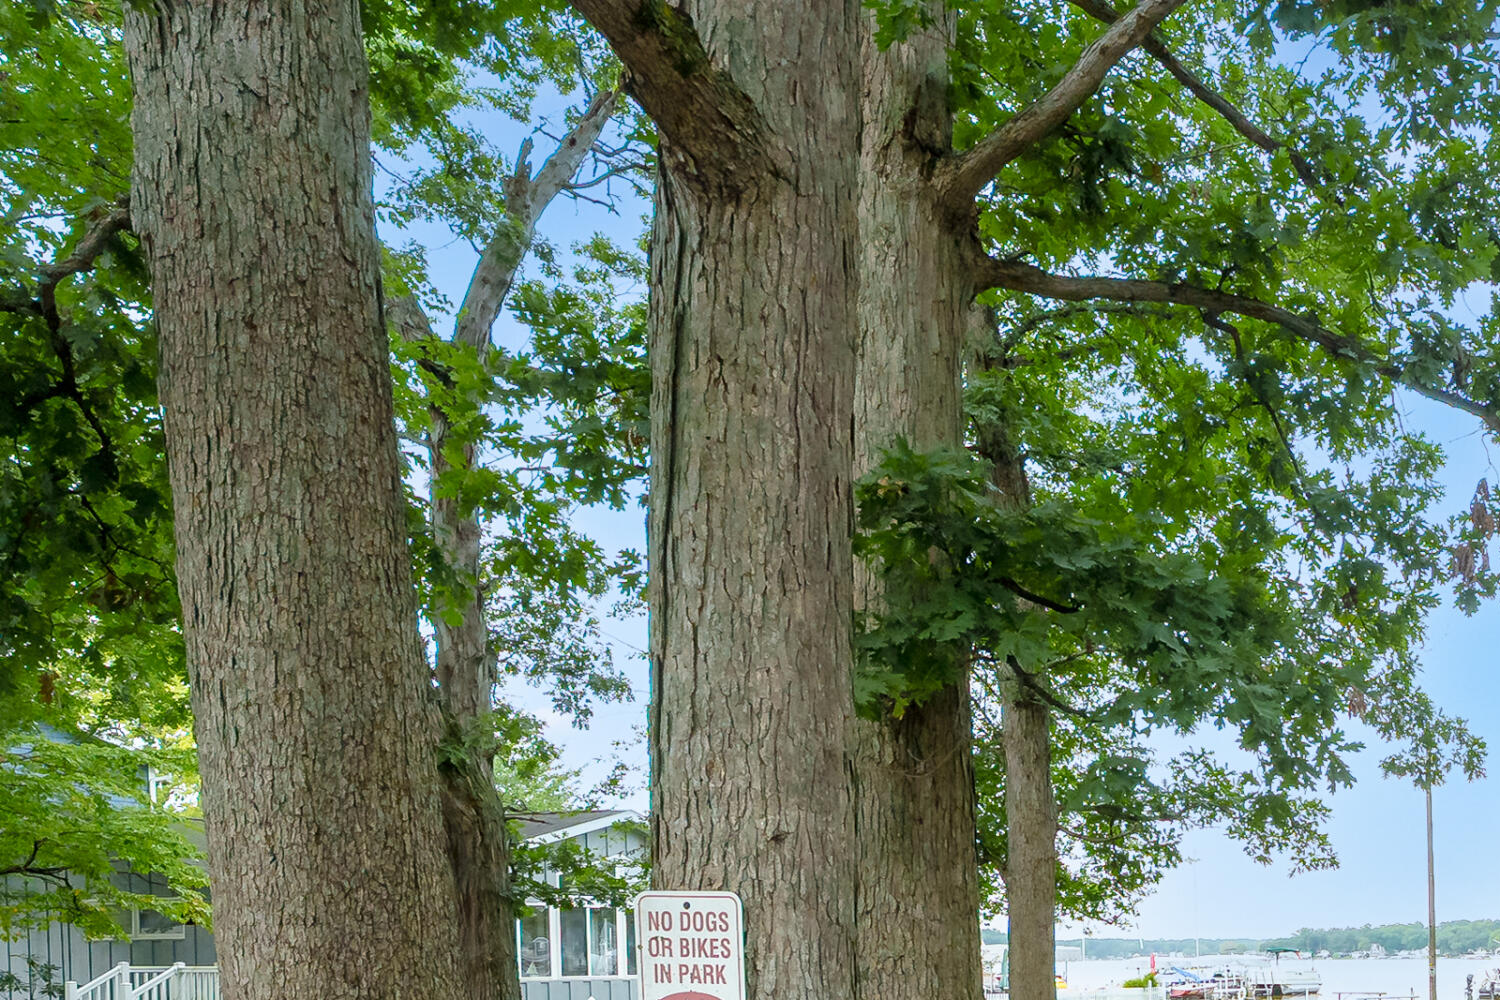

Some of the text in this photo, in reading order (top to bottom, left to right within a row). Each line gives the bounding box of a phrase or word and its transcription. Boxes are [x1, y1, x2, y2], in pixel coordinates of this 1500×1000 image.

[648, 911, 729, 932] NO DOGS
[648, 936, 731, 959] OR BIKES
[654, 964, 727, 984] IN PARK
